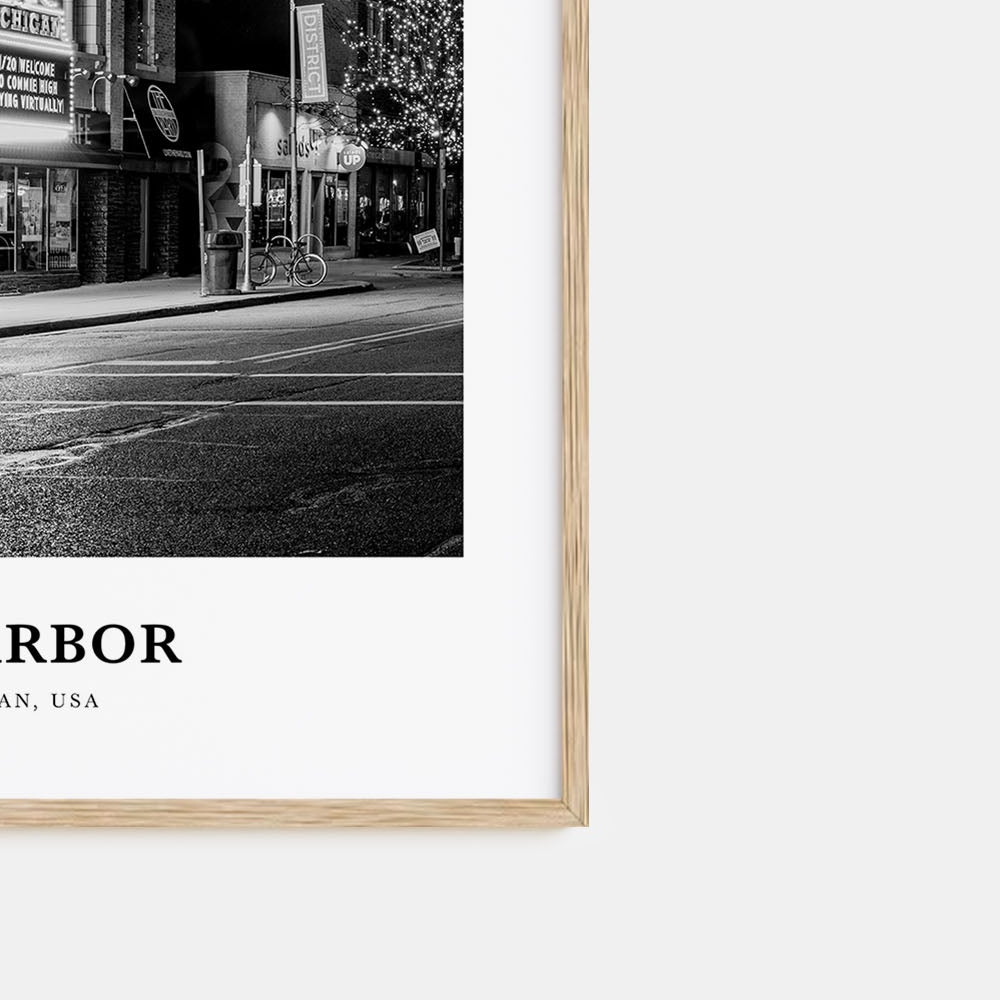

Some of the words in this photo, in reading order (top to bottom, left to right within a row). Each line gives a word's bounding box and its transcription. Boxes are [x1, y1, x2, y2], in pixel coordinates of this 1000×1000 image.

[304, 15, 321, 93] DISTRICT
[19, 57, 55, 77] WELCOME
[39, 79, 58, 95] HIGH
[21, 94, 65, 114] VIRTUALLY
[344, 154, 361, 166] UP
[51, 692, 100, 709] USA
